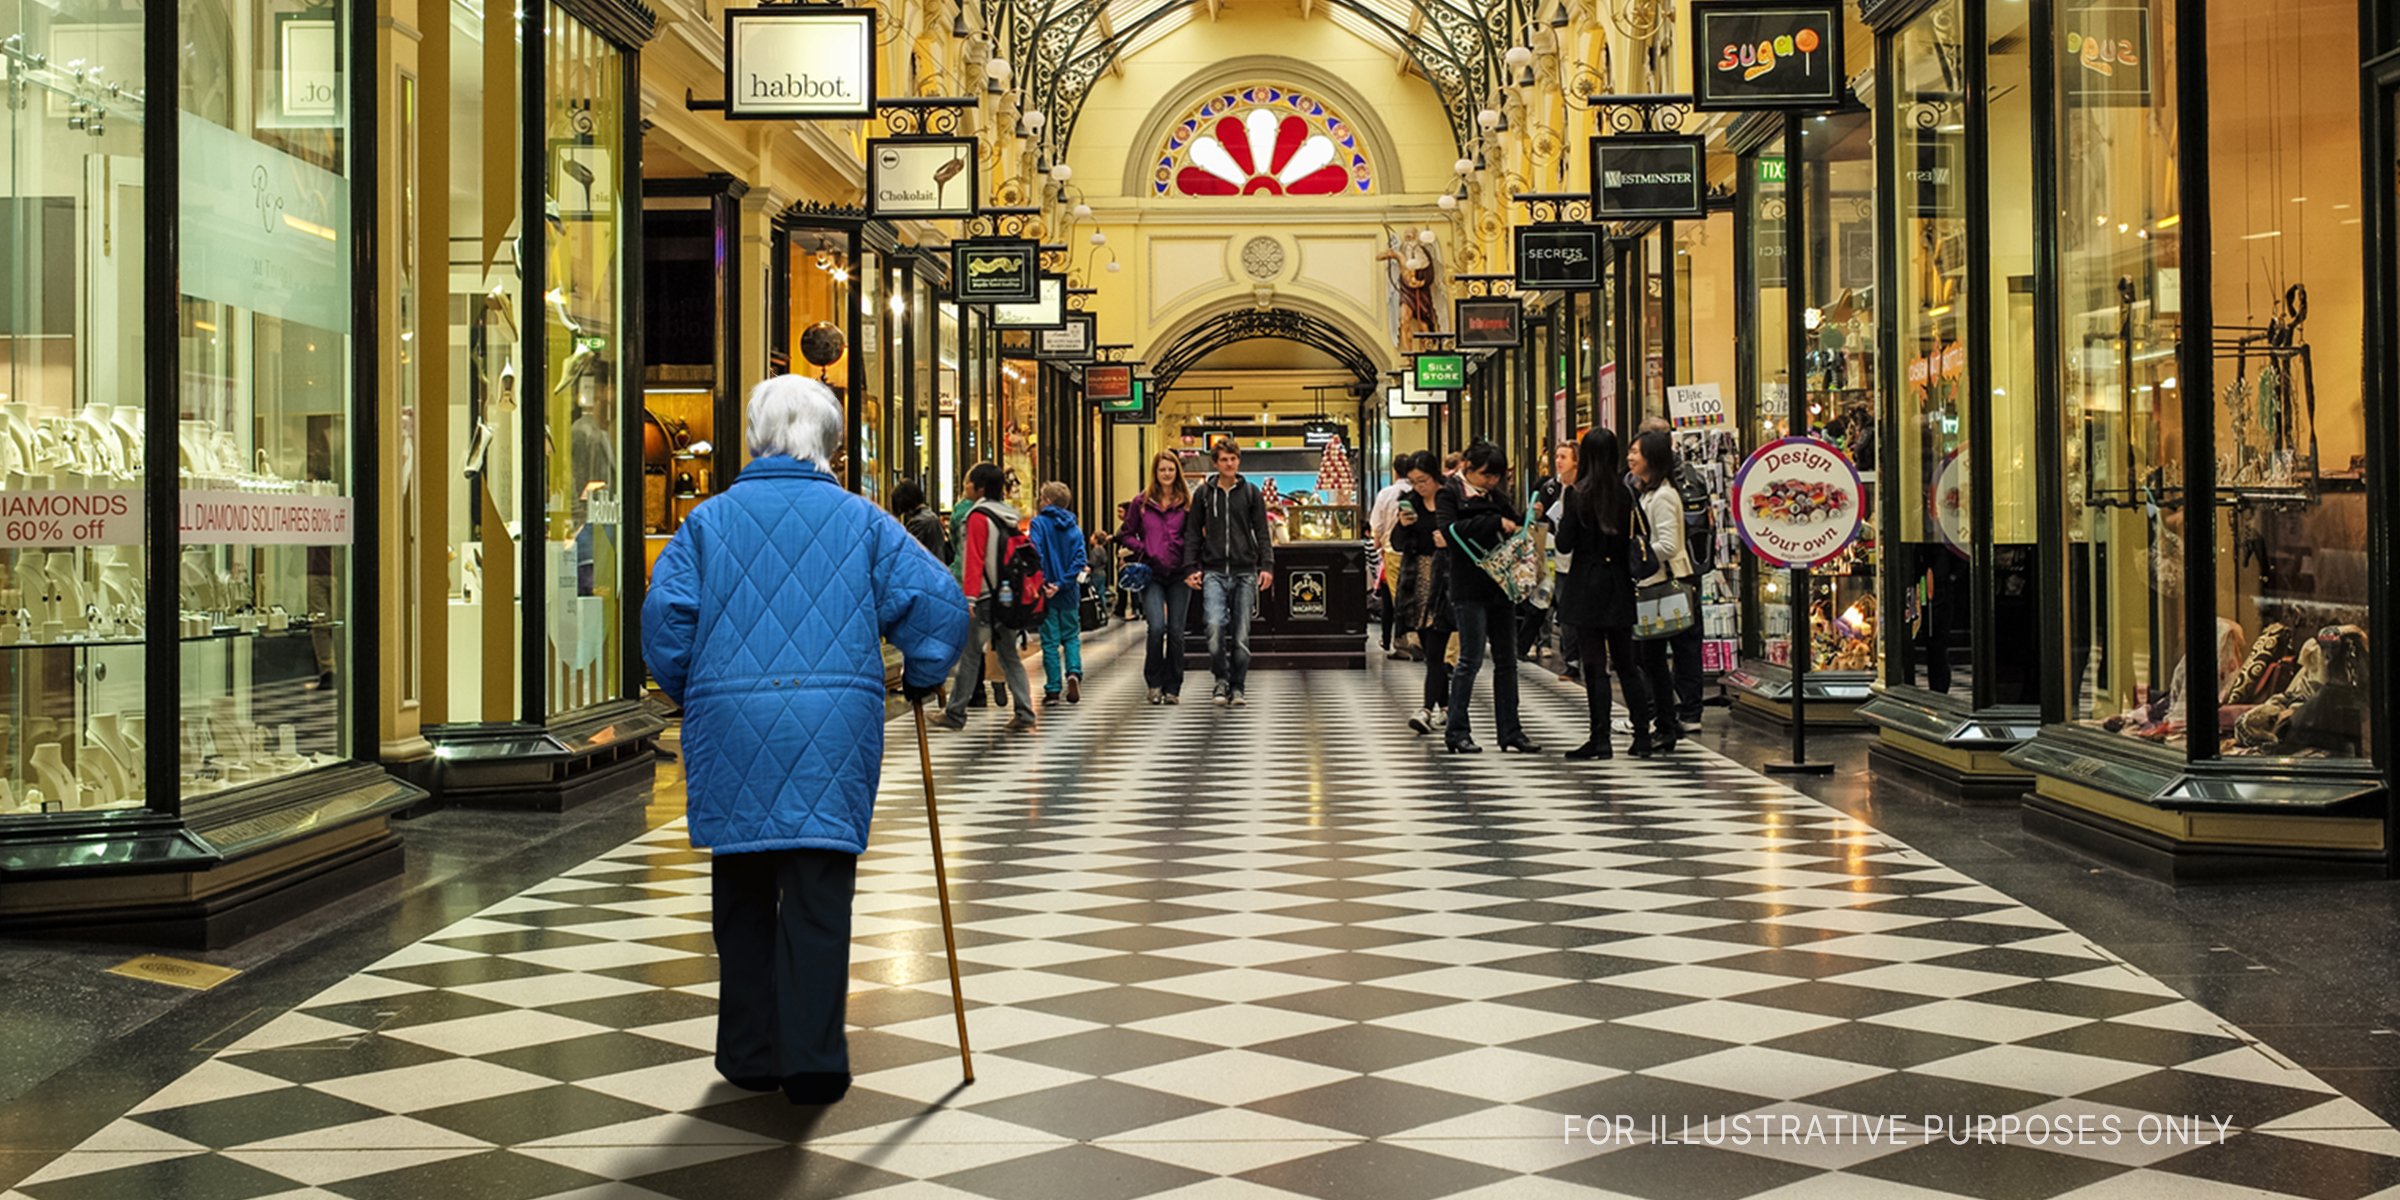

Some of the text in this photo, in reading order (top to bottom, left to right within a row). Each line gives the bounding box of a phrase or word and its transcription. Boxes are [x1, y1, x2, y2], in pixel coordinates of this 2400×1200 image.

[751, 73, 851, 97] habbot.
[1604, 170, 1692, 188] WESTMINSTER
[879, 190, 938, 202] Chokolait.
[1528, 247, 1583, 260] SECRETS
[1422, 372, 1459, 381] STORE
[1427, 363, 1453, 371] SILK
[1765, 448, 1833, 473] Design
[1, 494, 128, 517] IAMONDS
[178, 503, 347, 533] LL DIAMOND SOLITAIRES 60% off
[6, 519, 105, 541] 60% off
[1755, 527, 1838, 552] your own
